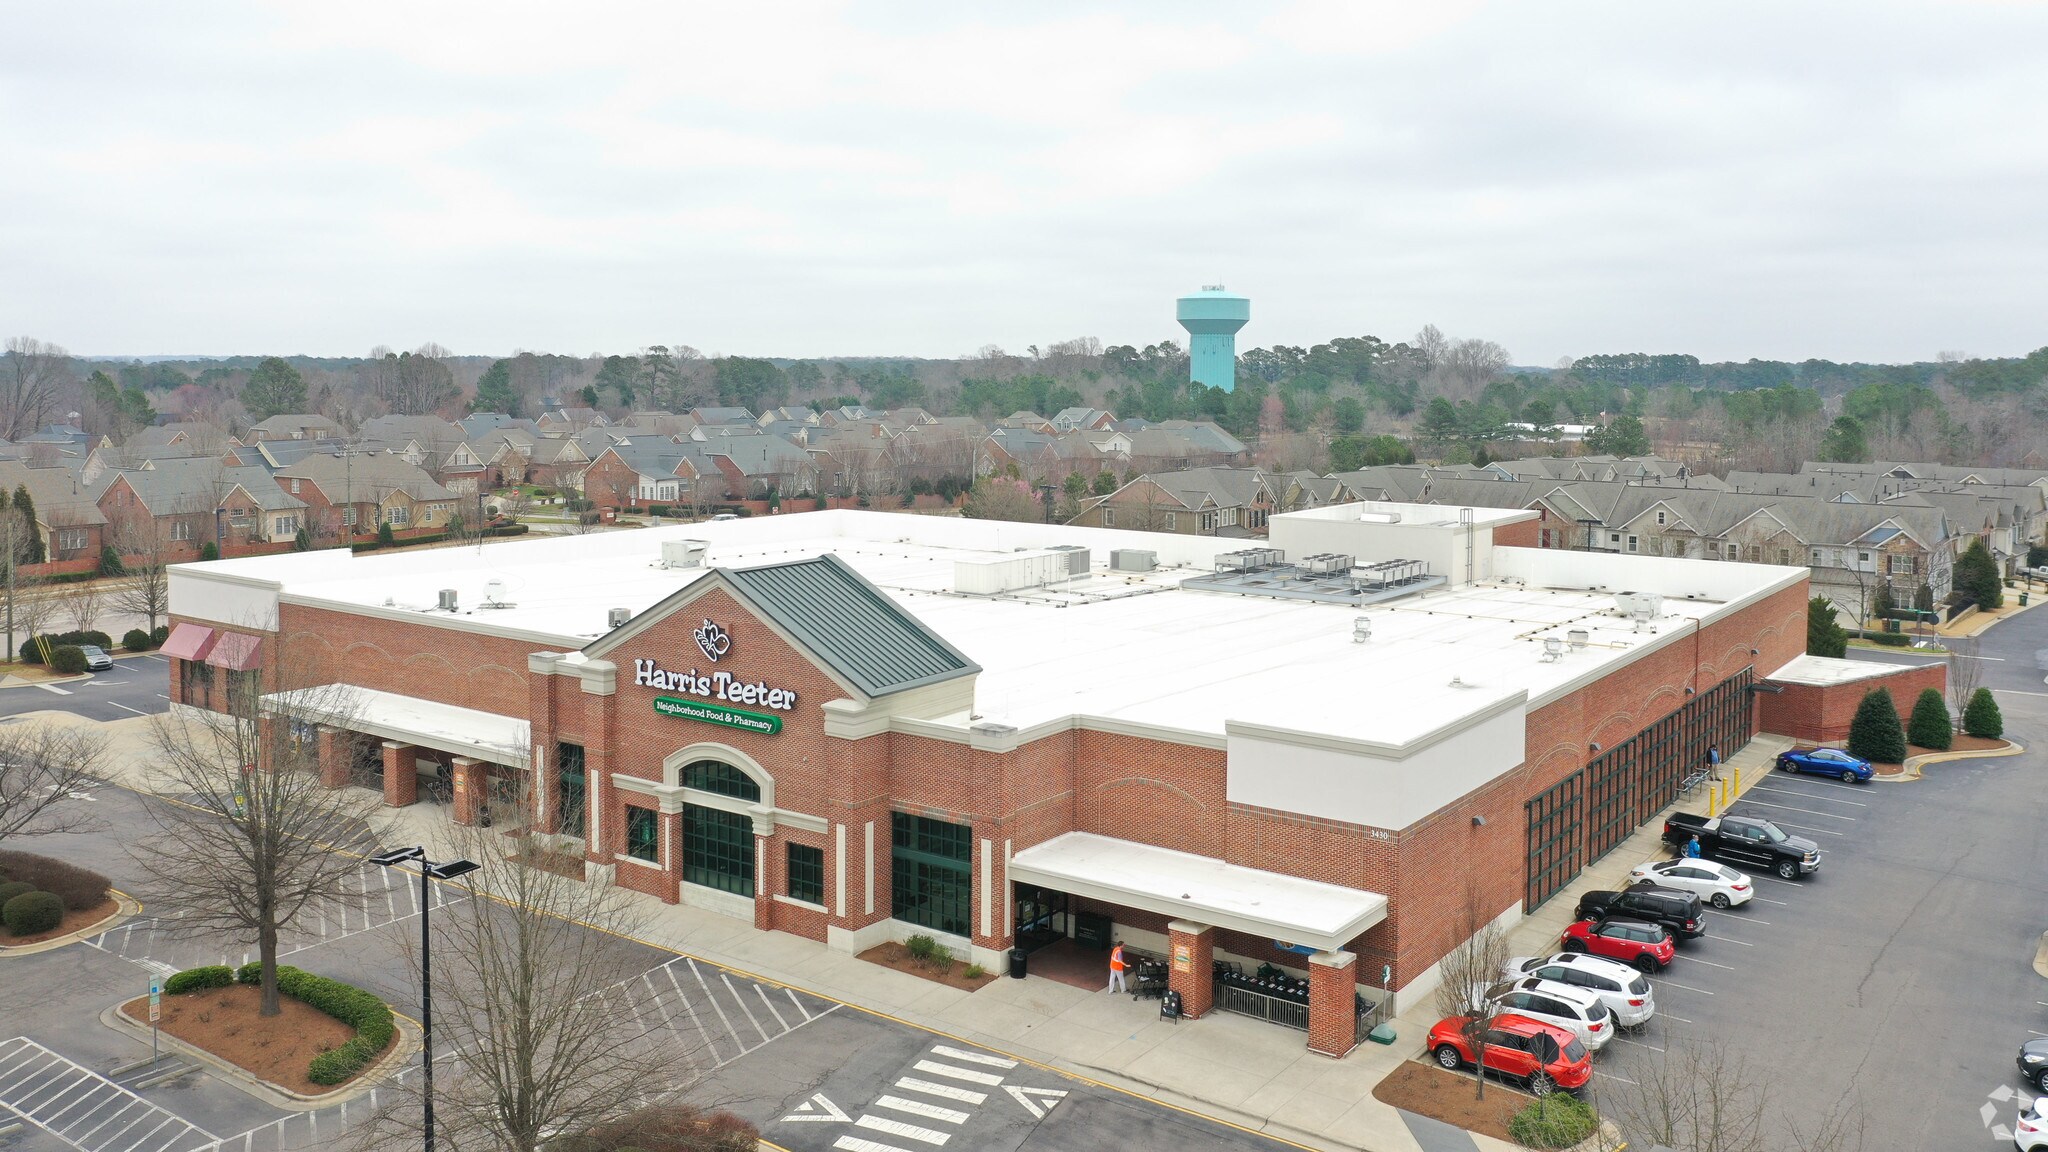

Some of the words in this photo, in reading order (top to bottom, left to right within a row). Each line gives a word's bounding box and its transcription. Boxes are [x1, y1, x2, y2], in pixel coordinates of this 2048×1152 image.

[635, 659, 710, 696] Harris
[713, 671, 795, 710] Teeter
[656, 701, 705, 718] Neighborhood
[706, 710, 724, 722] Food
[724, 713, 733, 723] &
[733, 715, 773, 732] Pharmacy
[1371, 829, 1388, 840] 3430
